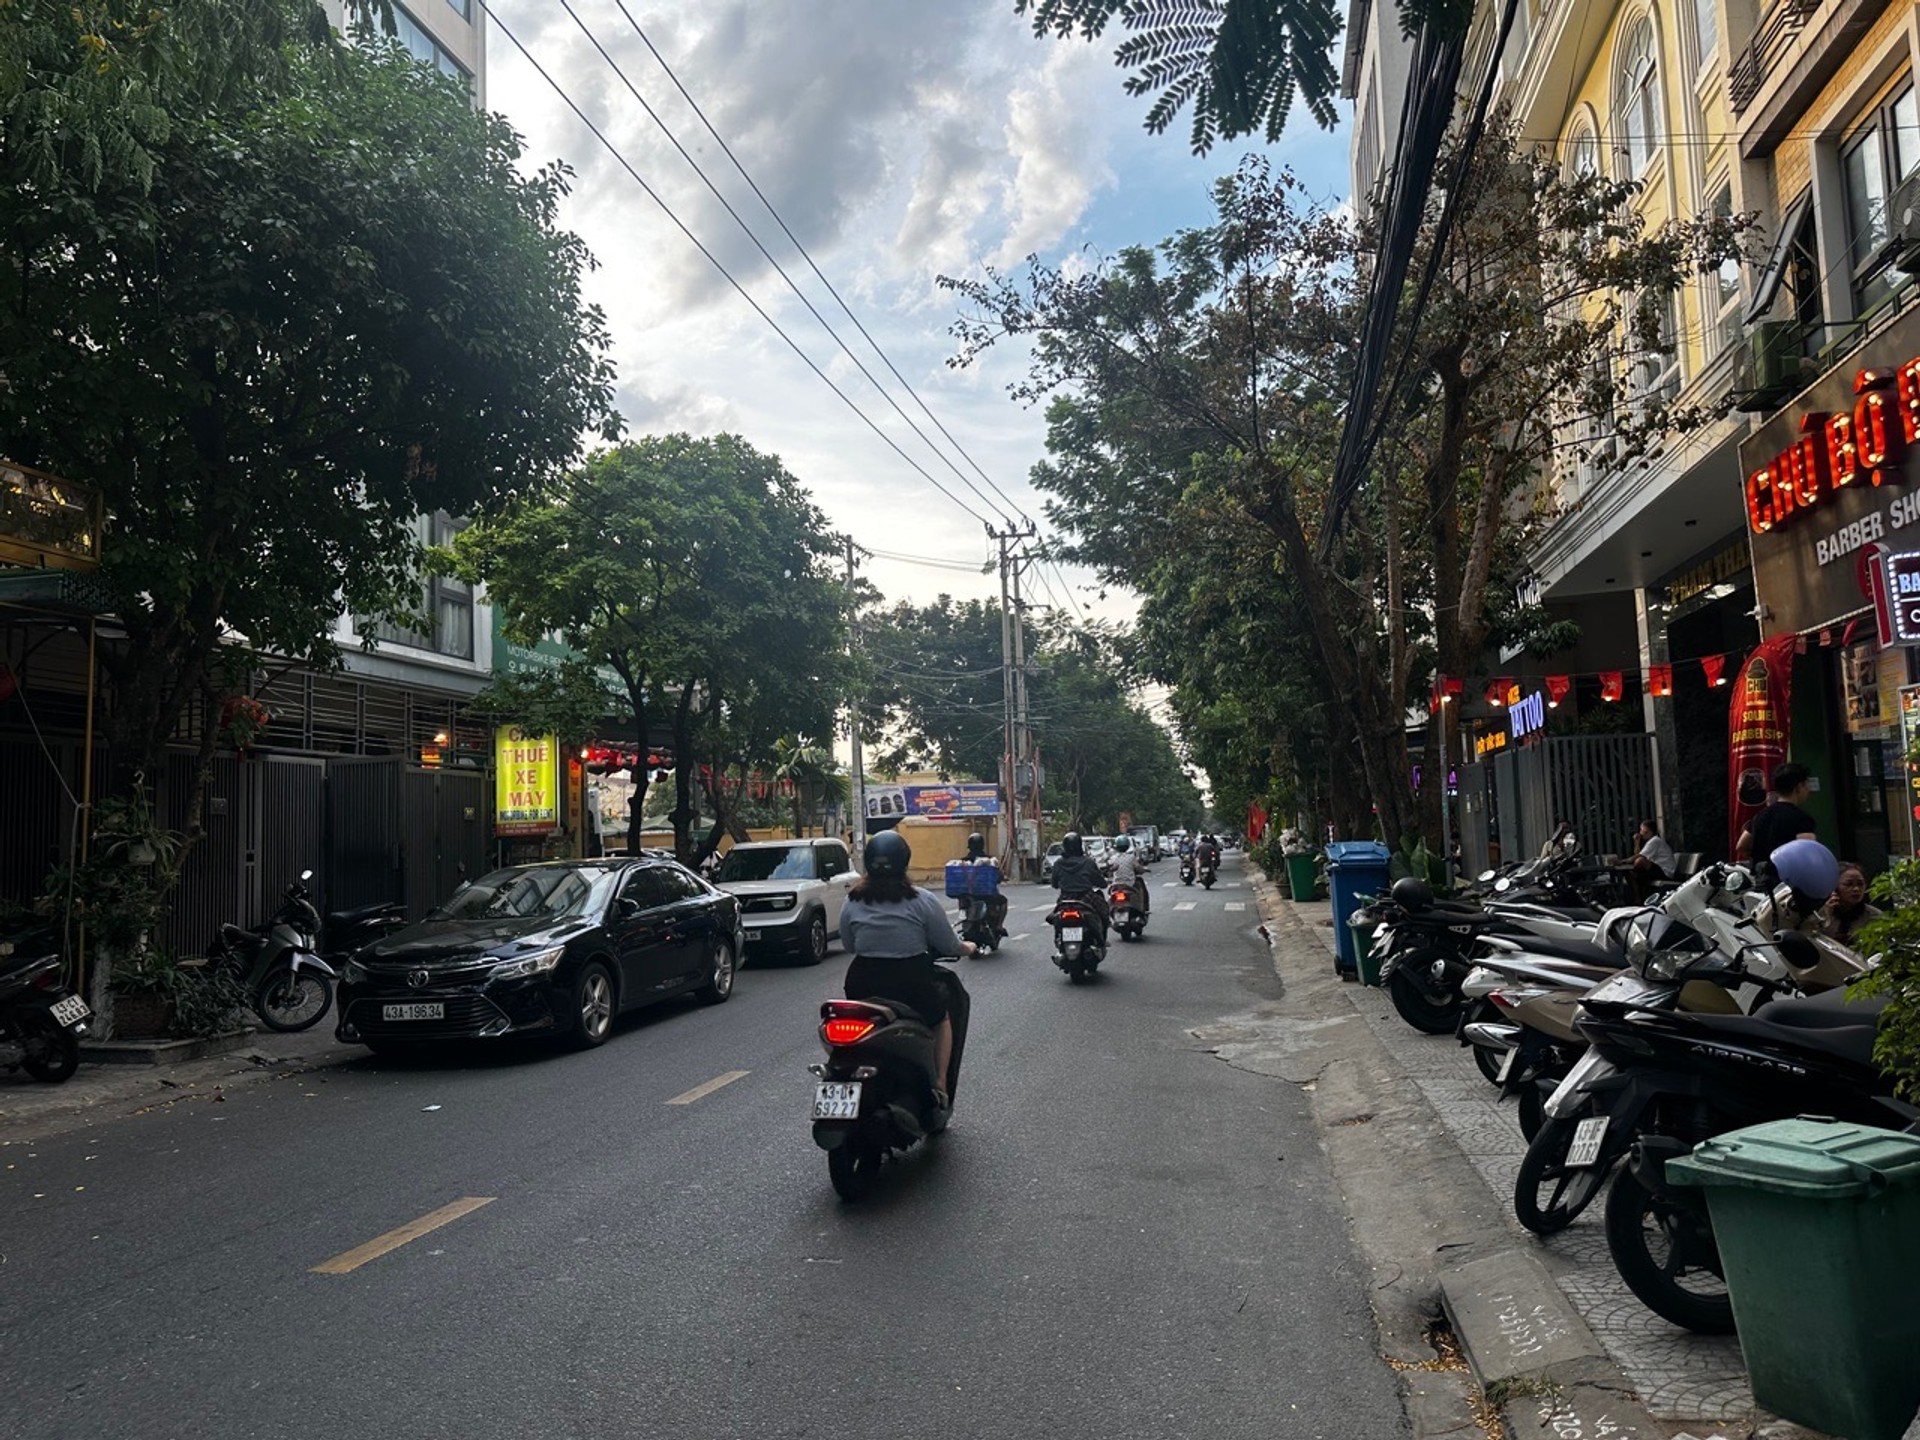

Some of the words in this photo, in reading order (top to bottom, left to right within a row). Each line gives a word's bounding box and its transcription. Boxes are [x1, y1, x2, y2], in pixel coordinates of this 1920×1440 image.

[1816, 511, 1885, 566] BARBER
[1509, 690, 1544, 737] TATTOO
[502, 743, 548, 763] THUÊ
[515, 769, 537, 785] XE
[509, 787, 546, 807] MÁY
